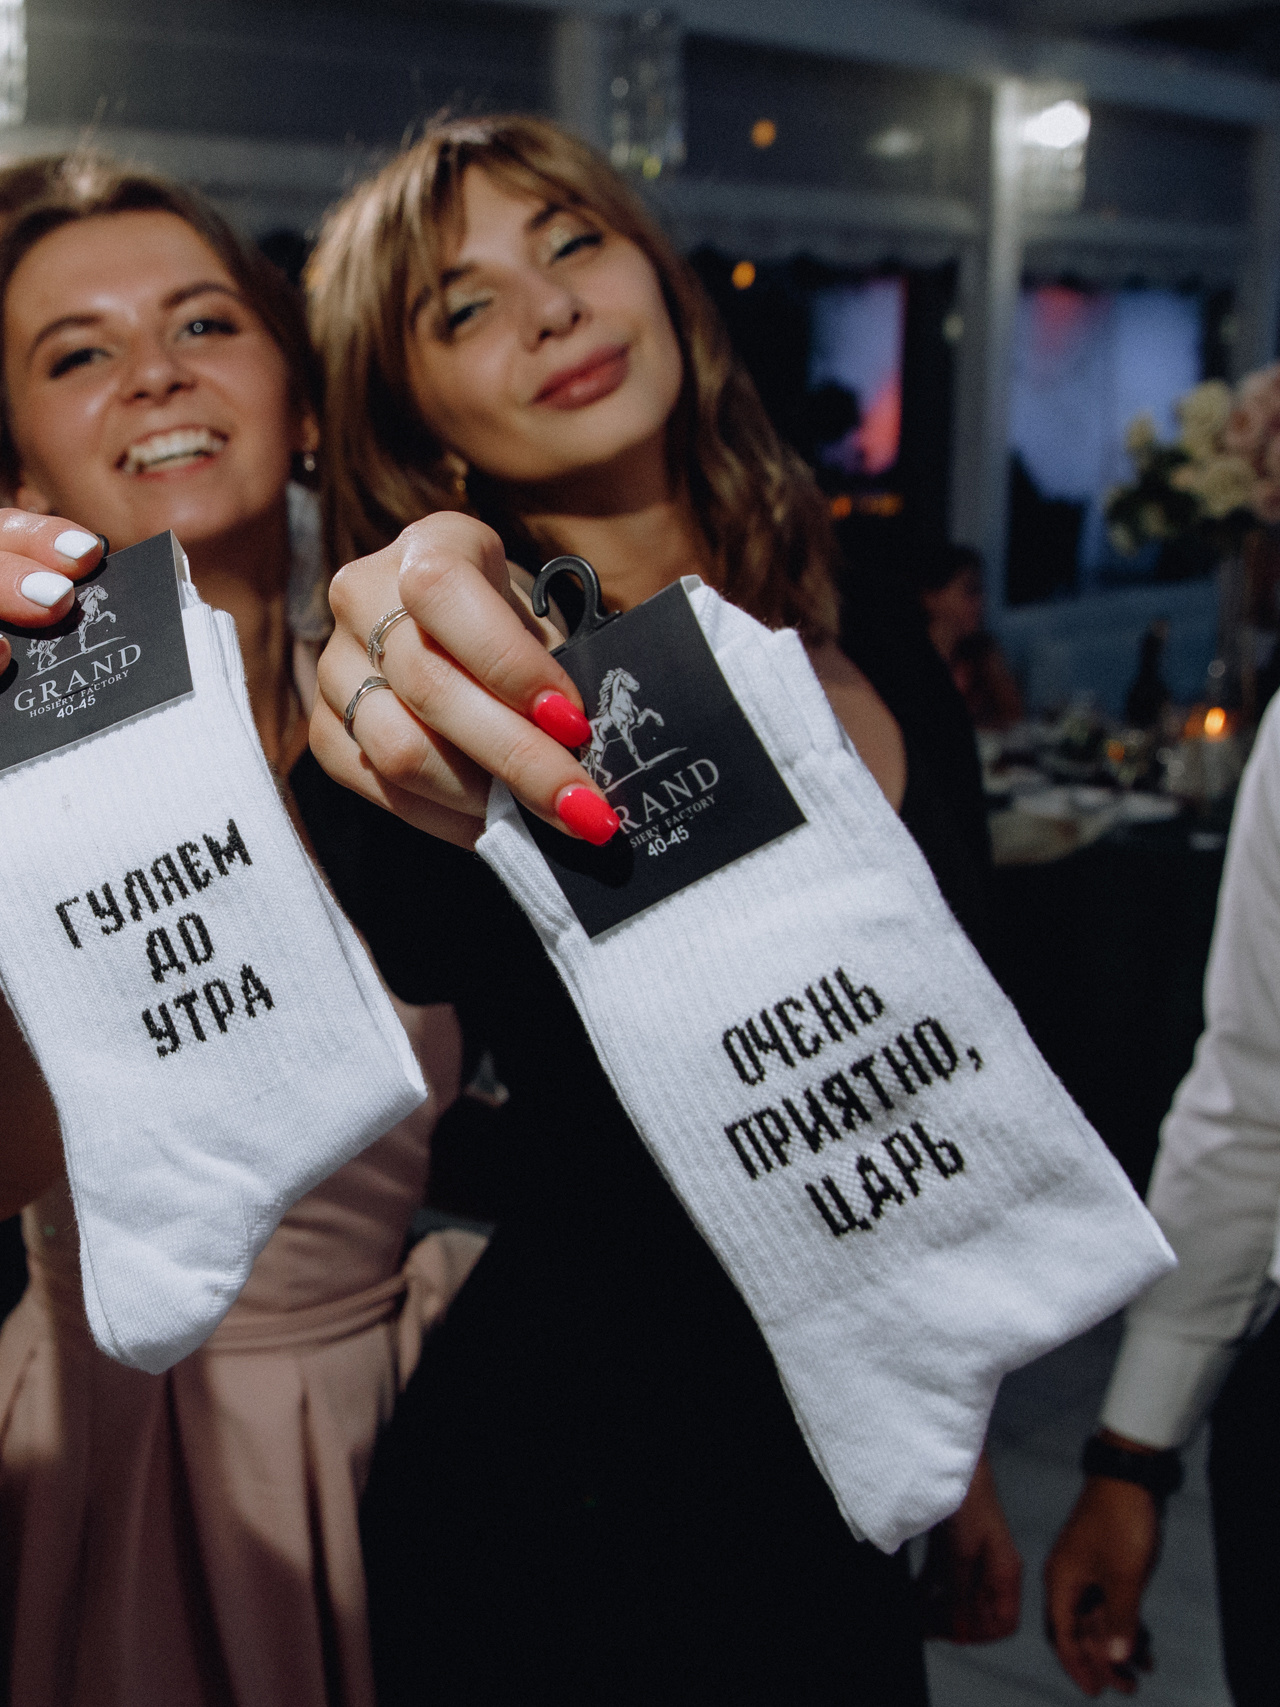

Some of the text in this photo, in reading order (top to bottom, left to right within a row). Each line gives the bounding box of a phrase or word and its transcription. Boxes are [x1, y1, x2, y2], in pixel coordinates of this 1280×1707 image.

[13, 644, 142, 712] GRAND
[29, 669, 129, 718] HOSIERY FACTORY
[56, 695, 97, 719] 40-45
[613, 758, 720, 835] RAND
[628, 793, 717, 849] SIERY FACTORY
[647, 824, 690, 857] 40-45
[55, 818, 253, 949] ГУЛЯЕМ
[146, 912, 215, 983] ДО
[141, 963, 275, 1058] УТРА
[722, 966, 885, 1086] ОЧЕНЬ
[723, 1016, 983, 1180] ПРИЯТНО,
[805, 1121, 965, 1237] ЦАРЬ
